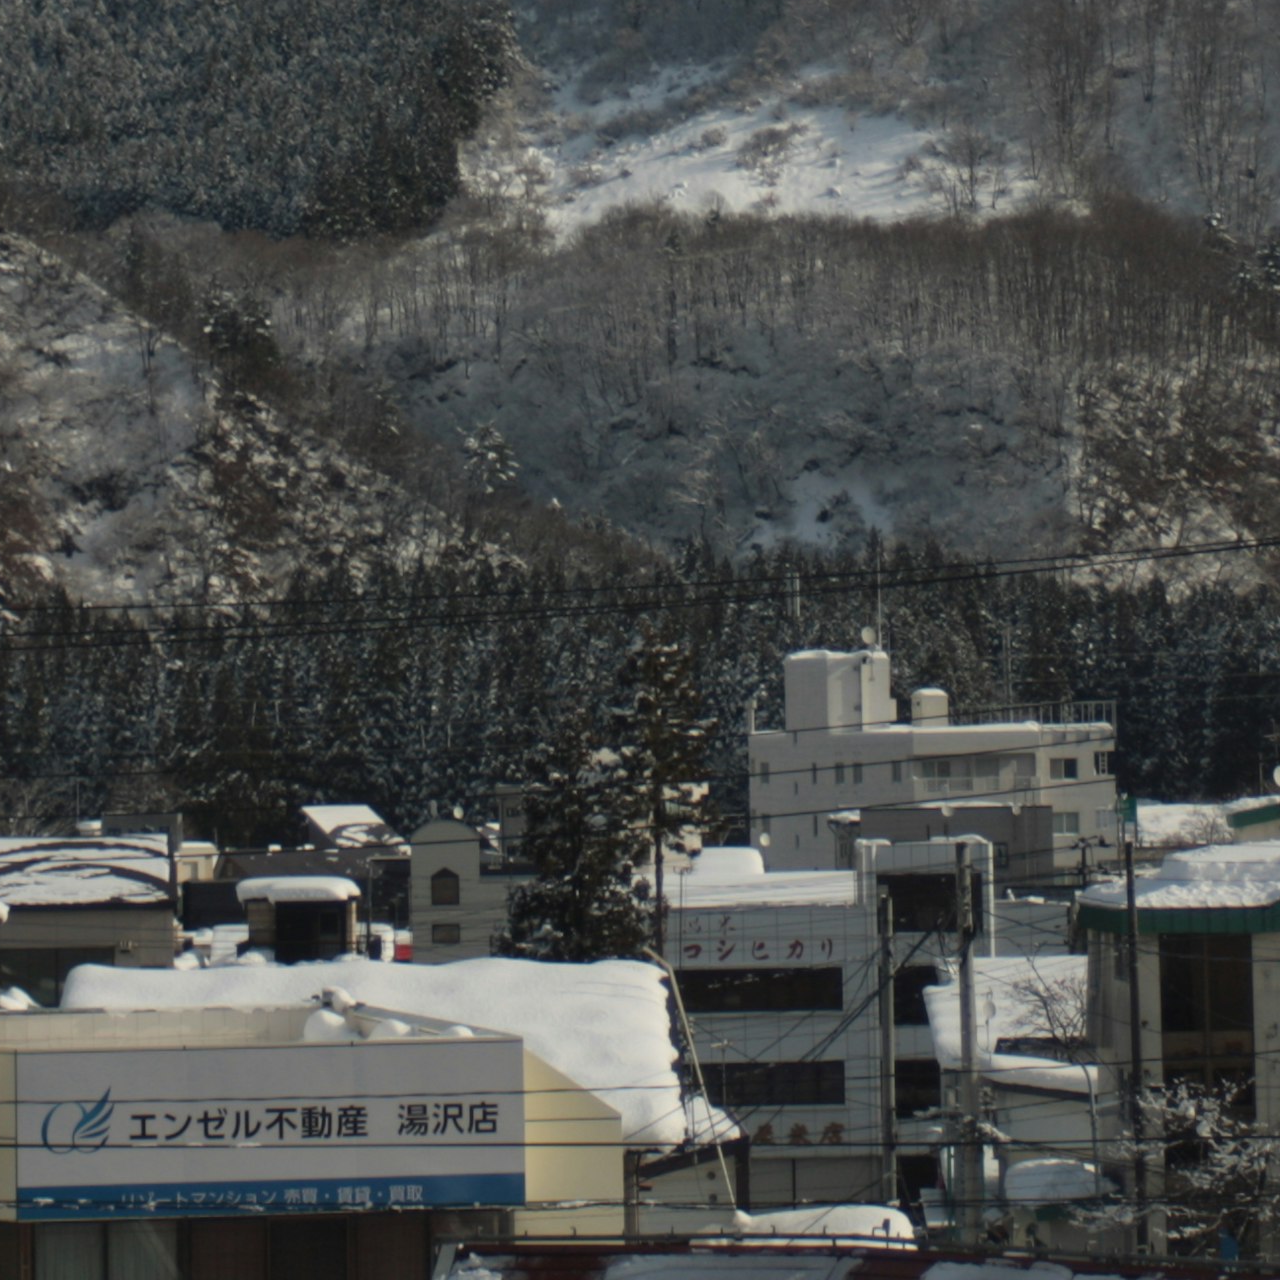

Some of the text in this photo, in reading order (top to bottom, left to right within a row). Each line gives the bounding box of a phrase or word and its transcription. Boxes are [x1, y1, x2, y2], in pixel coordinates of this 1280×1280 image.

[683, 937, 833, 961] コシヒカリ
[129, 1101, 499, 1141] エンゼル不動産 湯沢店
